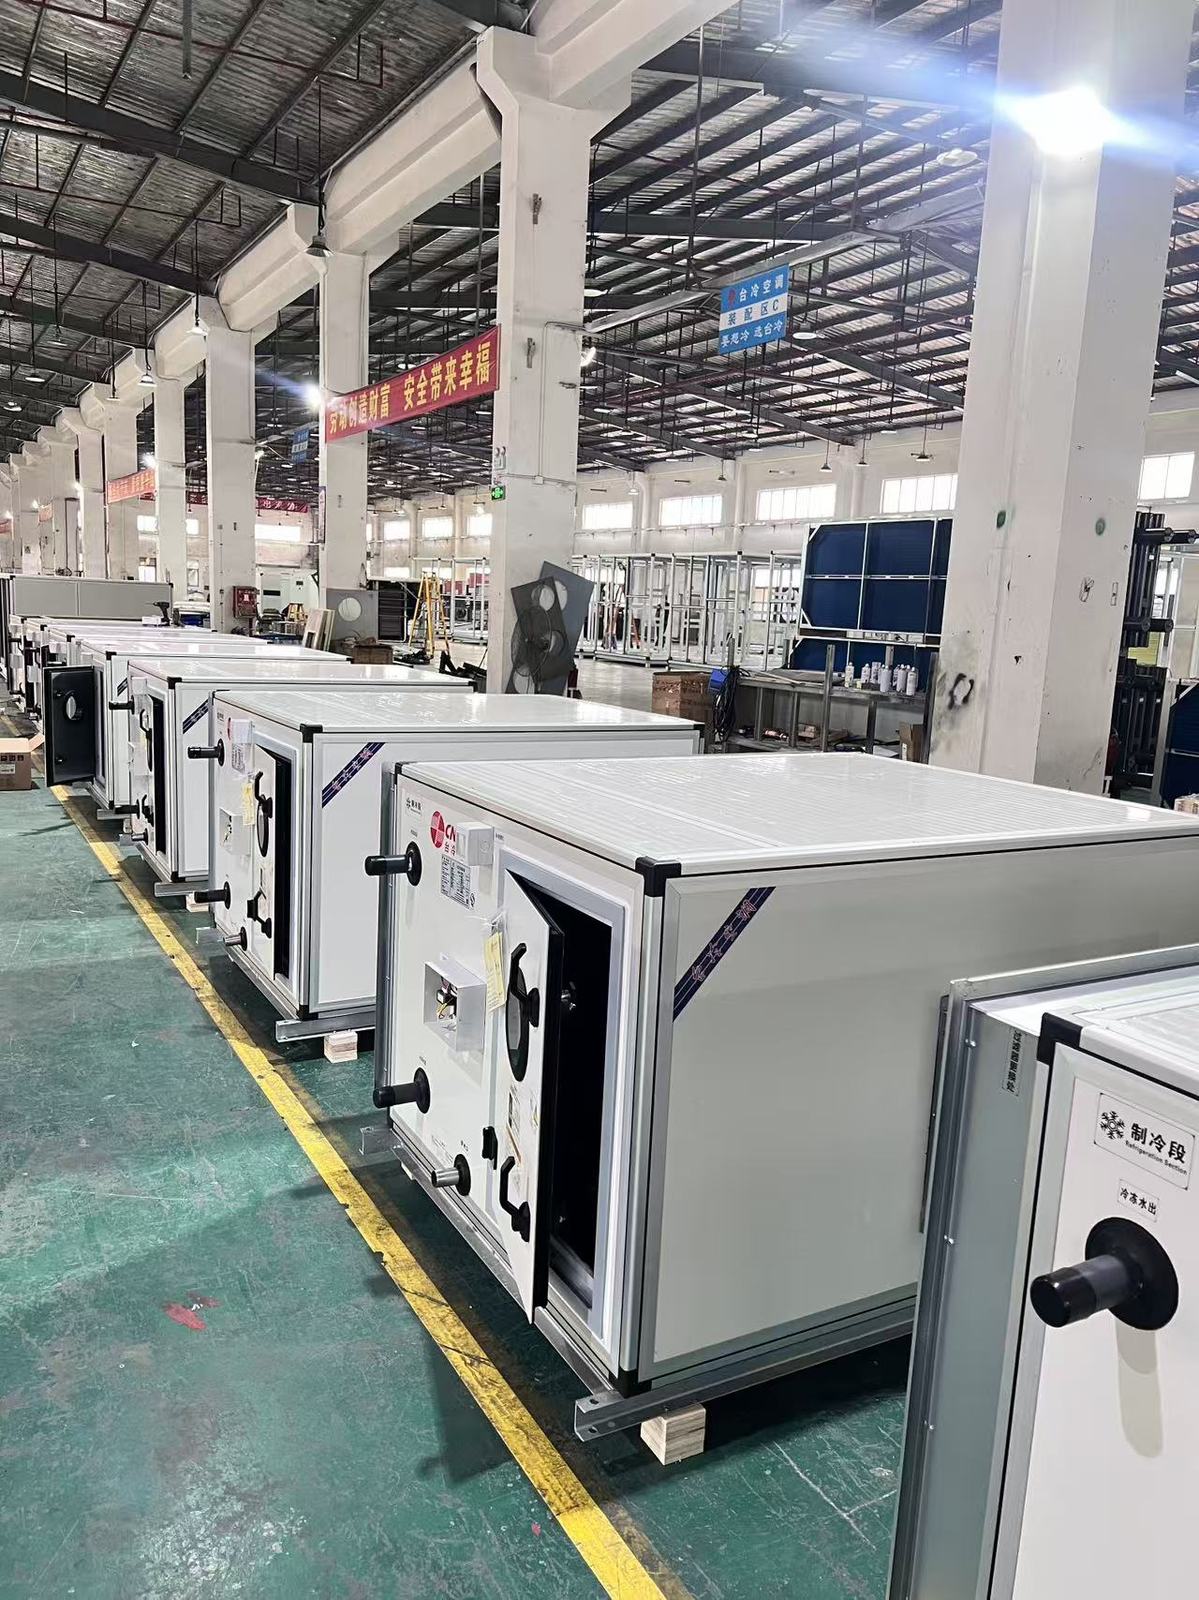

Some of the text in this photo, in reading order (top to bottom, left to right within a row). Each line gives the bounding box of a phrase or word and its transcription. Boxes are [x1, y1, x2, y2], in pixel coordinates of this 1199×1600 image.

[403, 341, 491, 411] 安全带来幸福
[1130, 1122, 1186, 1164] 制冷段
[1120, 1187, 1157, 1215] 冷冻水出
